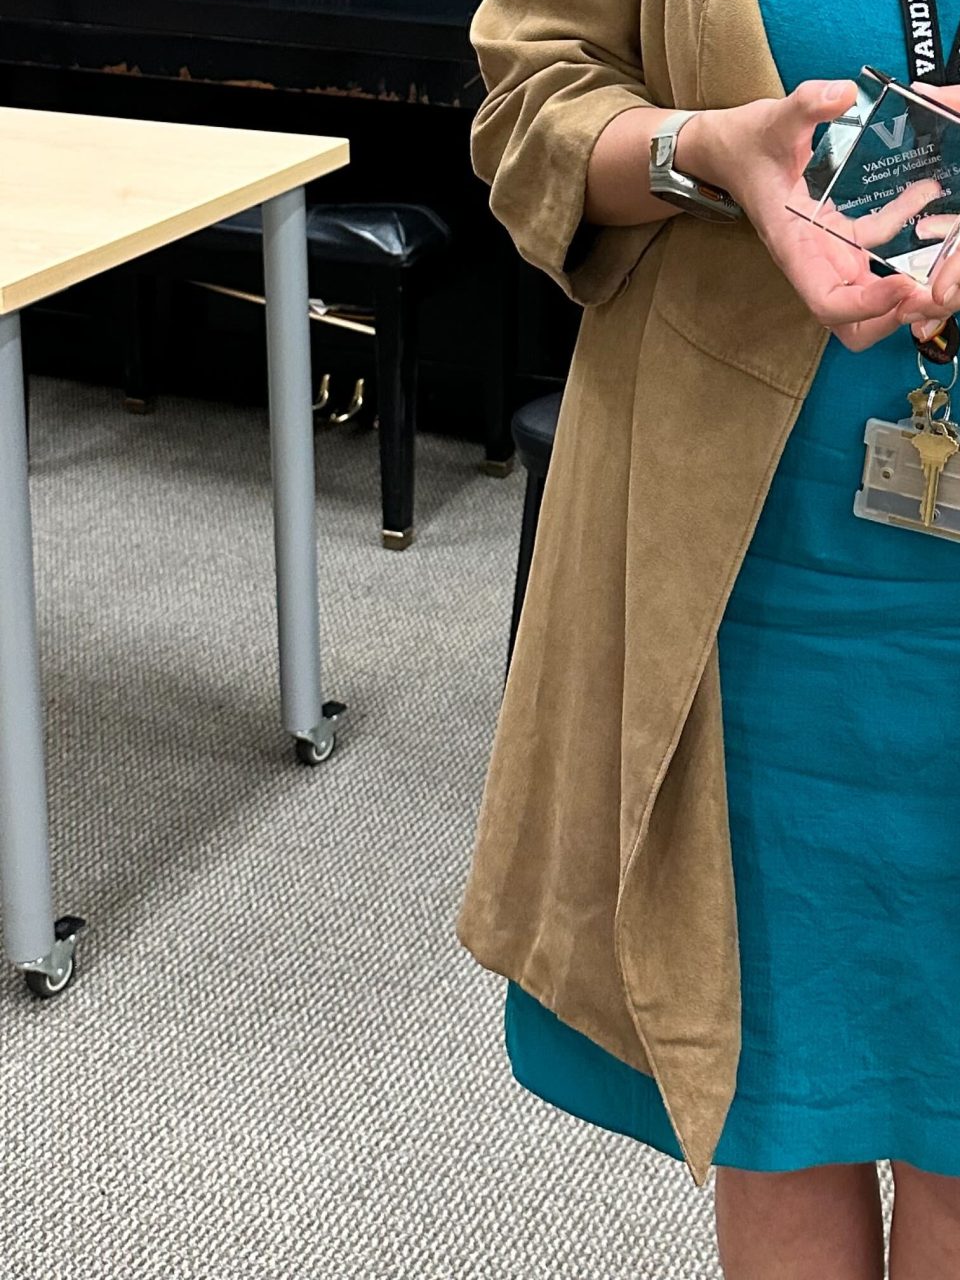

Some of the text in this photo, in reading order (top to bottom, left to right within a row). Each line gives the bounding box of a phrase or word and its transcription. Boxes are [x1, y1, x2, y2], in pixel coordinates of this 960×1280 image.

[862, 143, 936, 173] VANDERBILT
[862, 154, 942, 185] School of Medicine
[835, 193, 873, 211] anderbilt
[874, 188, 895, 201] Prize
